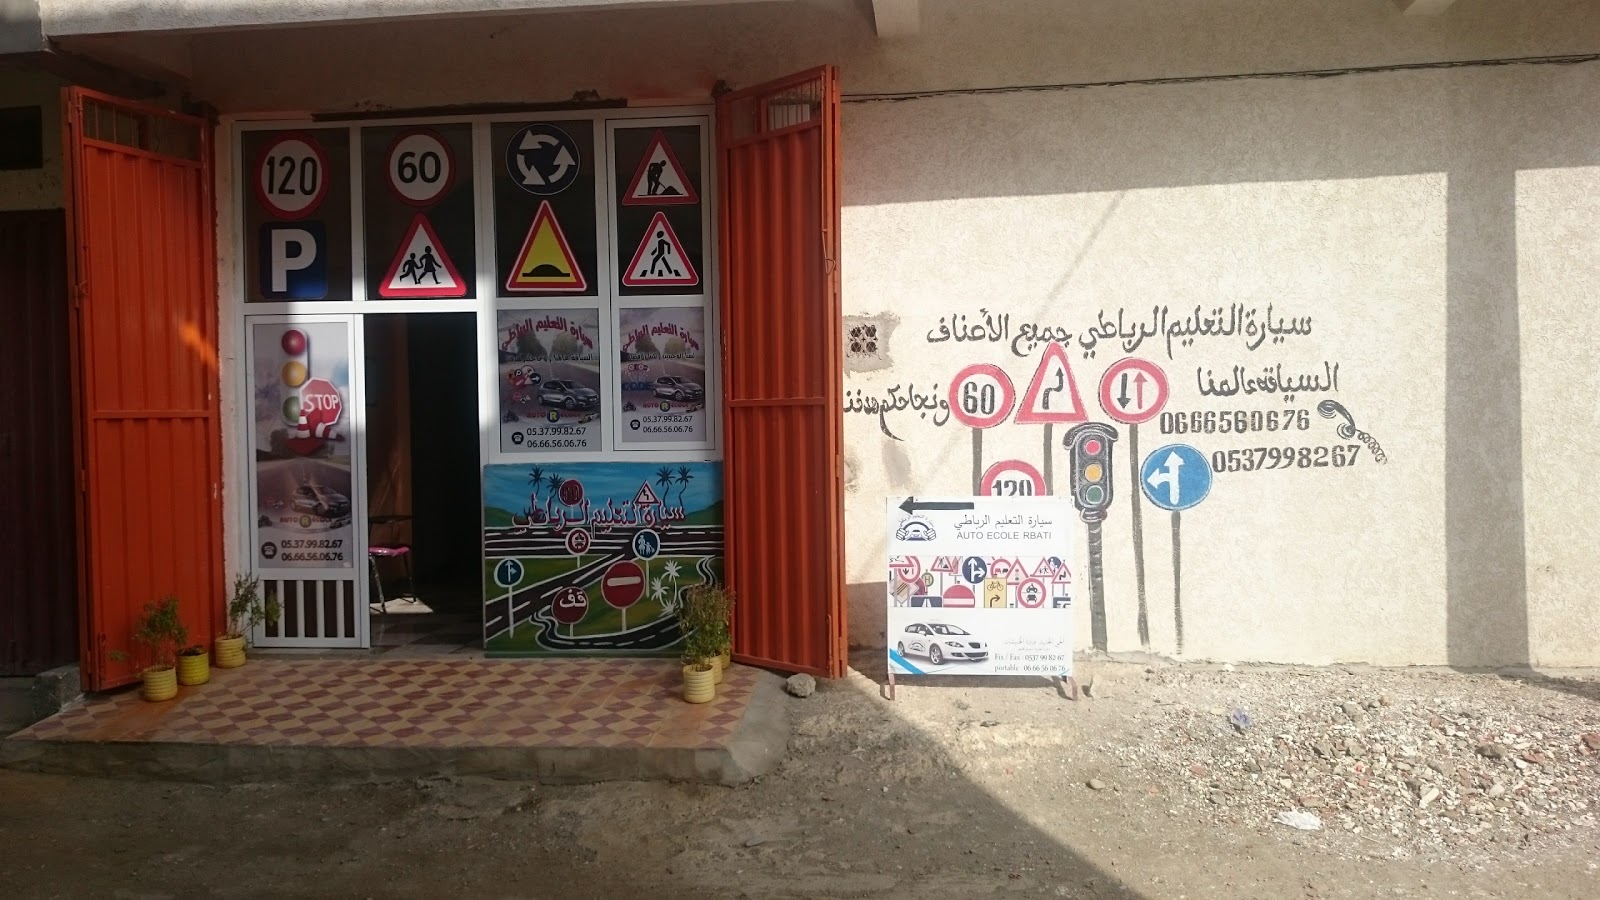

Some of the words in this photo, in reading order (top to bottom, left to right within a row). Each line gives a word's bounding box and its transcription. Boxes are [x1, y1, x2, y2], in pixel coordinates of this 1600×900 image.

[266, 154, 318, 196] 120
[397, 150, 442, 184] 60
[270, 228, 317, 292] P
[535, 315, 568, 332] التعليم
[651, 322, 678, 337] التعليم
[926, 307, 1010, 343] الأصناف
[1078, 304, 1168, 360] الرباطي
[1167, 302, 1244, 360] التعليم
[1245, 302, 1312, 352] سيارة
[569, 320, 593, 350] سيارة
[679, 326, 700, 351] سيارة
[1011, 322, 1073, 358] جميع
[303, 393, 340, 413] STOP
[843, 388, 880, 416] هدفن
[963, 381, 996, 415] 60
[642, 415, 693, 424] 05.37.99.82.67
[642, 425, 693, 434] 06.66.56.06.76
[1160, 408, 1311, 435] 0666560676
[526, 426, 587, 437] 05.37.99.82.67
[526, 439, 587, 449] 06.66.56.06.76
[1212, 444, 1361, 474] 0537998267
[953, 514, 991, 530] الرباطي
[994, 514, 1023, 529] التعليم
[1028, 514, 1053, 529] سيارة
[281, 539, 343, 548] 05.37.99.82.67
[956, 531, 984, 540] AUTO
[986, 531, 1019, 540] ECOLE
[1023, 531, 1052, 540] RBATI
[281, 552, 343, 562] 06.66.56.06.76
[559, 589, 587, 609] قف
[994, 653, 1004, 661] Fix
[1009, 653, 1021, 661] Fax
[994, 664, 1019, 673] portable
